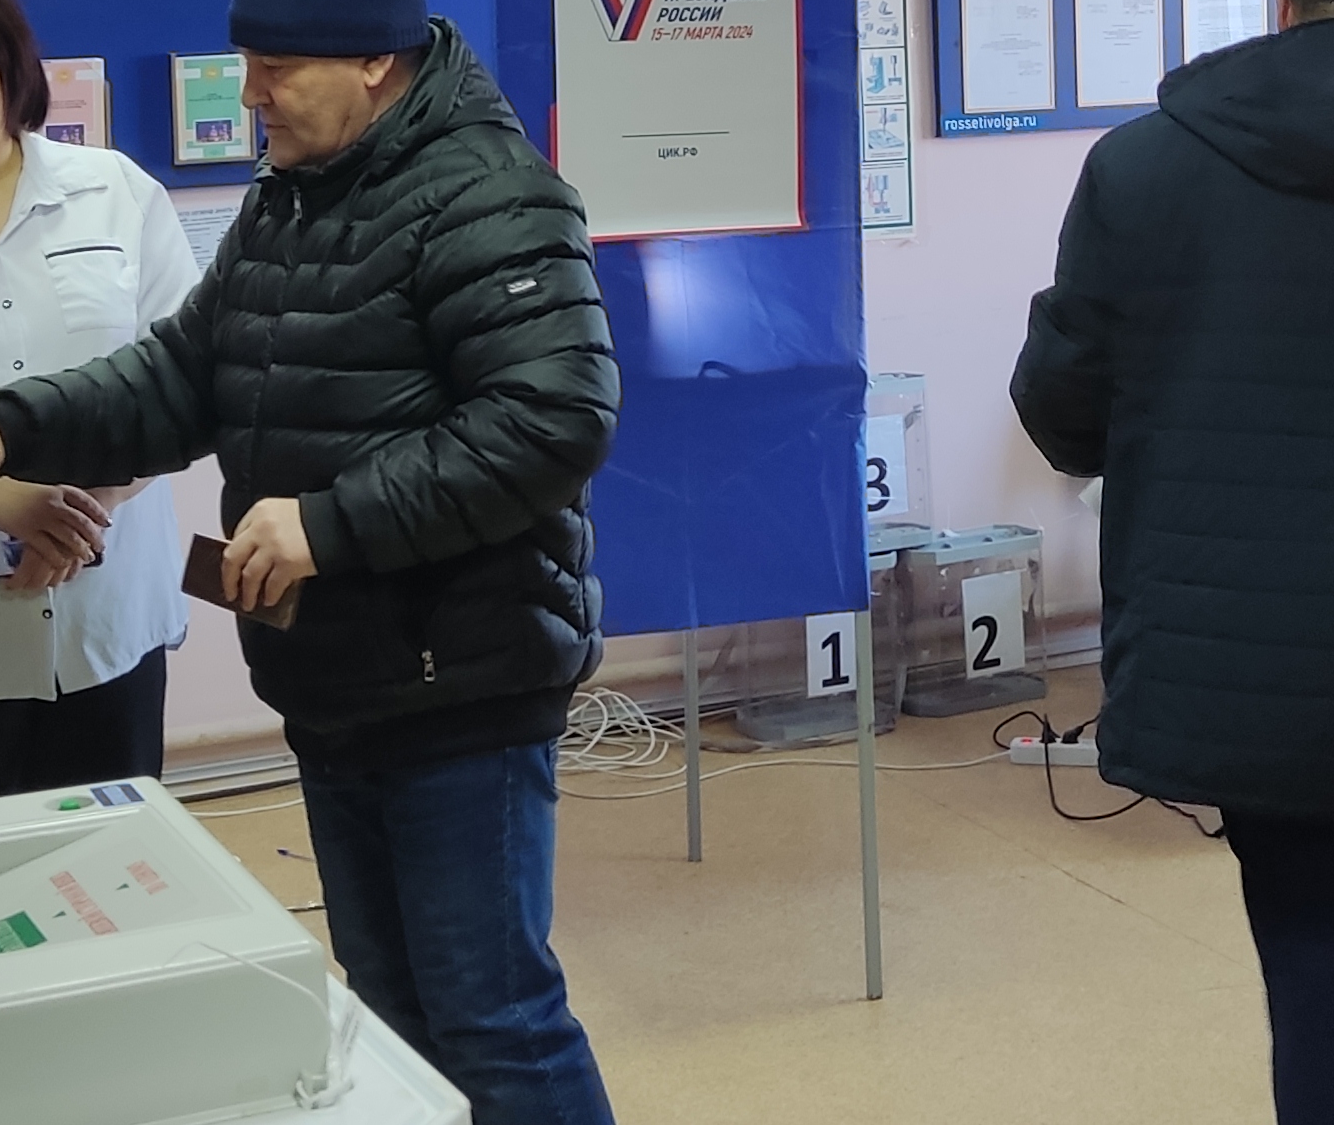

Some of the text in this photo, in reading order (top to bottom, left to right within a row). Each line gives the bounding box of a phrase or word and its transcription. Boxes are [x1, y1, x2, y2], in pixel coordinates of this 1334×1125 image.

[656, 6, 724, 23] РОССИИ
[683, 26, 723, 40] МАРТА
[725, 25, 754, 39] 2024
[944, 114, 1037, 132] rossetivolga.ru
[657, 147, 699, 159] ЦИК.РФ
[867, 457, 891, 513] 3
[971, 616, 1001, 671] 2
[821, 631, 850, 688] 1
